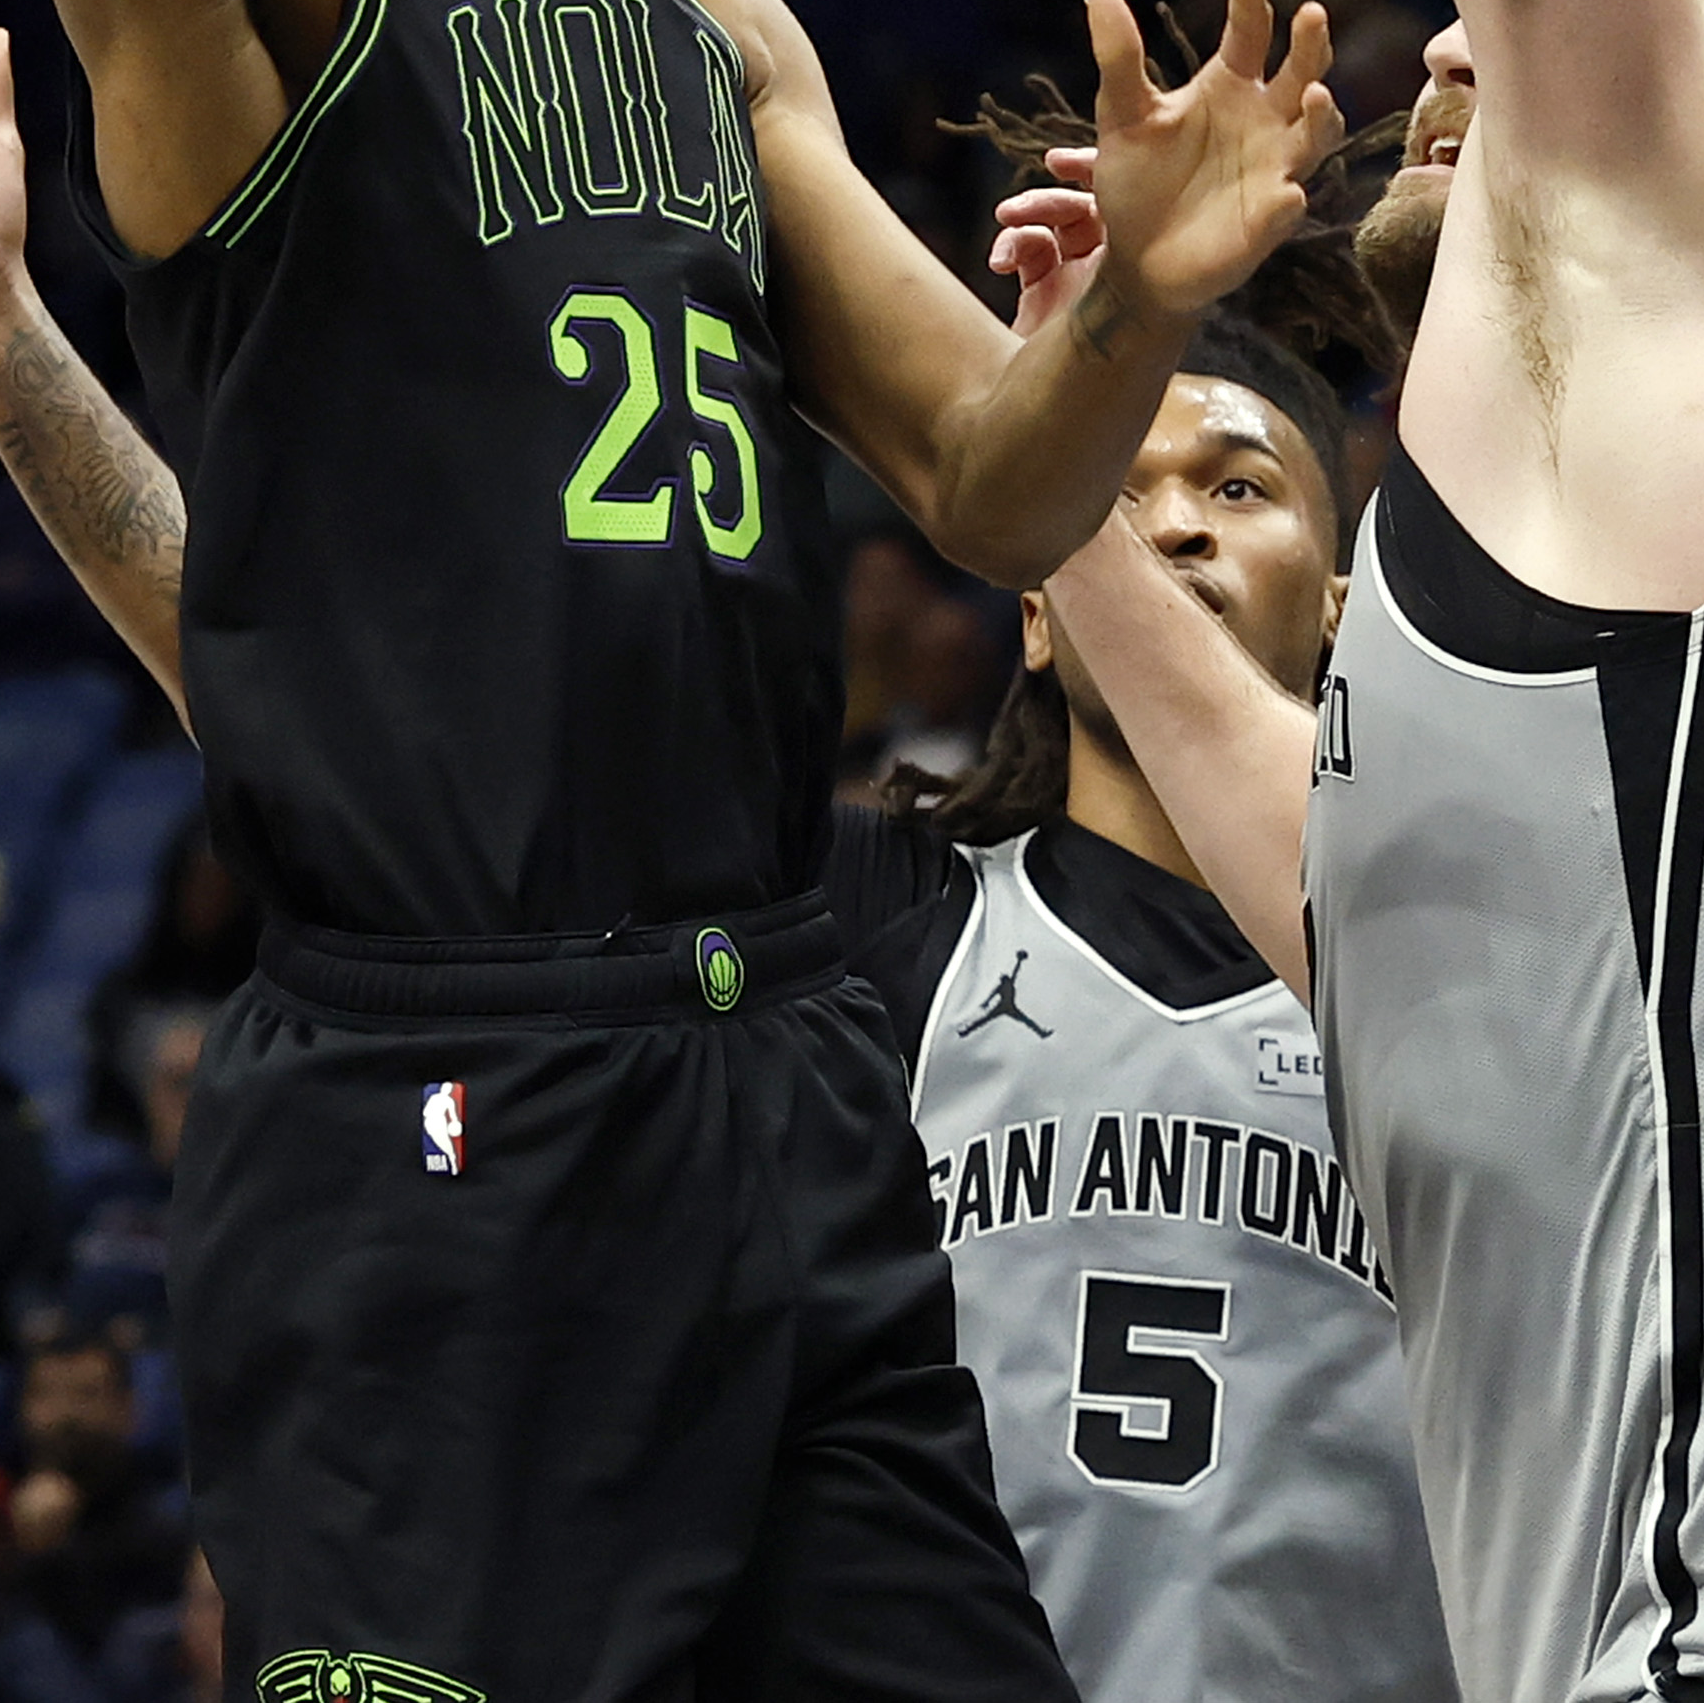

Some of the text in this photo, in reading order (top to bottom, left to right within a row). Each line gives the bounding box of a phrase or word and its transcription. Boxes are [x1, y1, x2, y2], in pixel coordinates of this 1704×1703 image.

[549, 285, 764, 563] 25
[1068, 1111, 1397, 1314] ANTONI
[1065, 1269, 1232, 1493] 5
